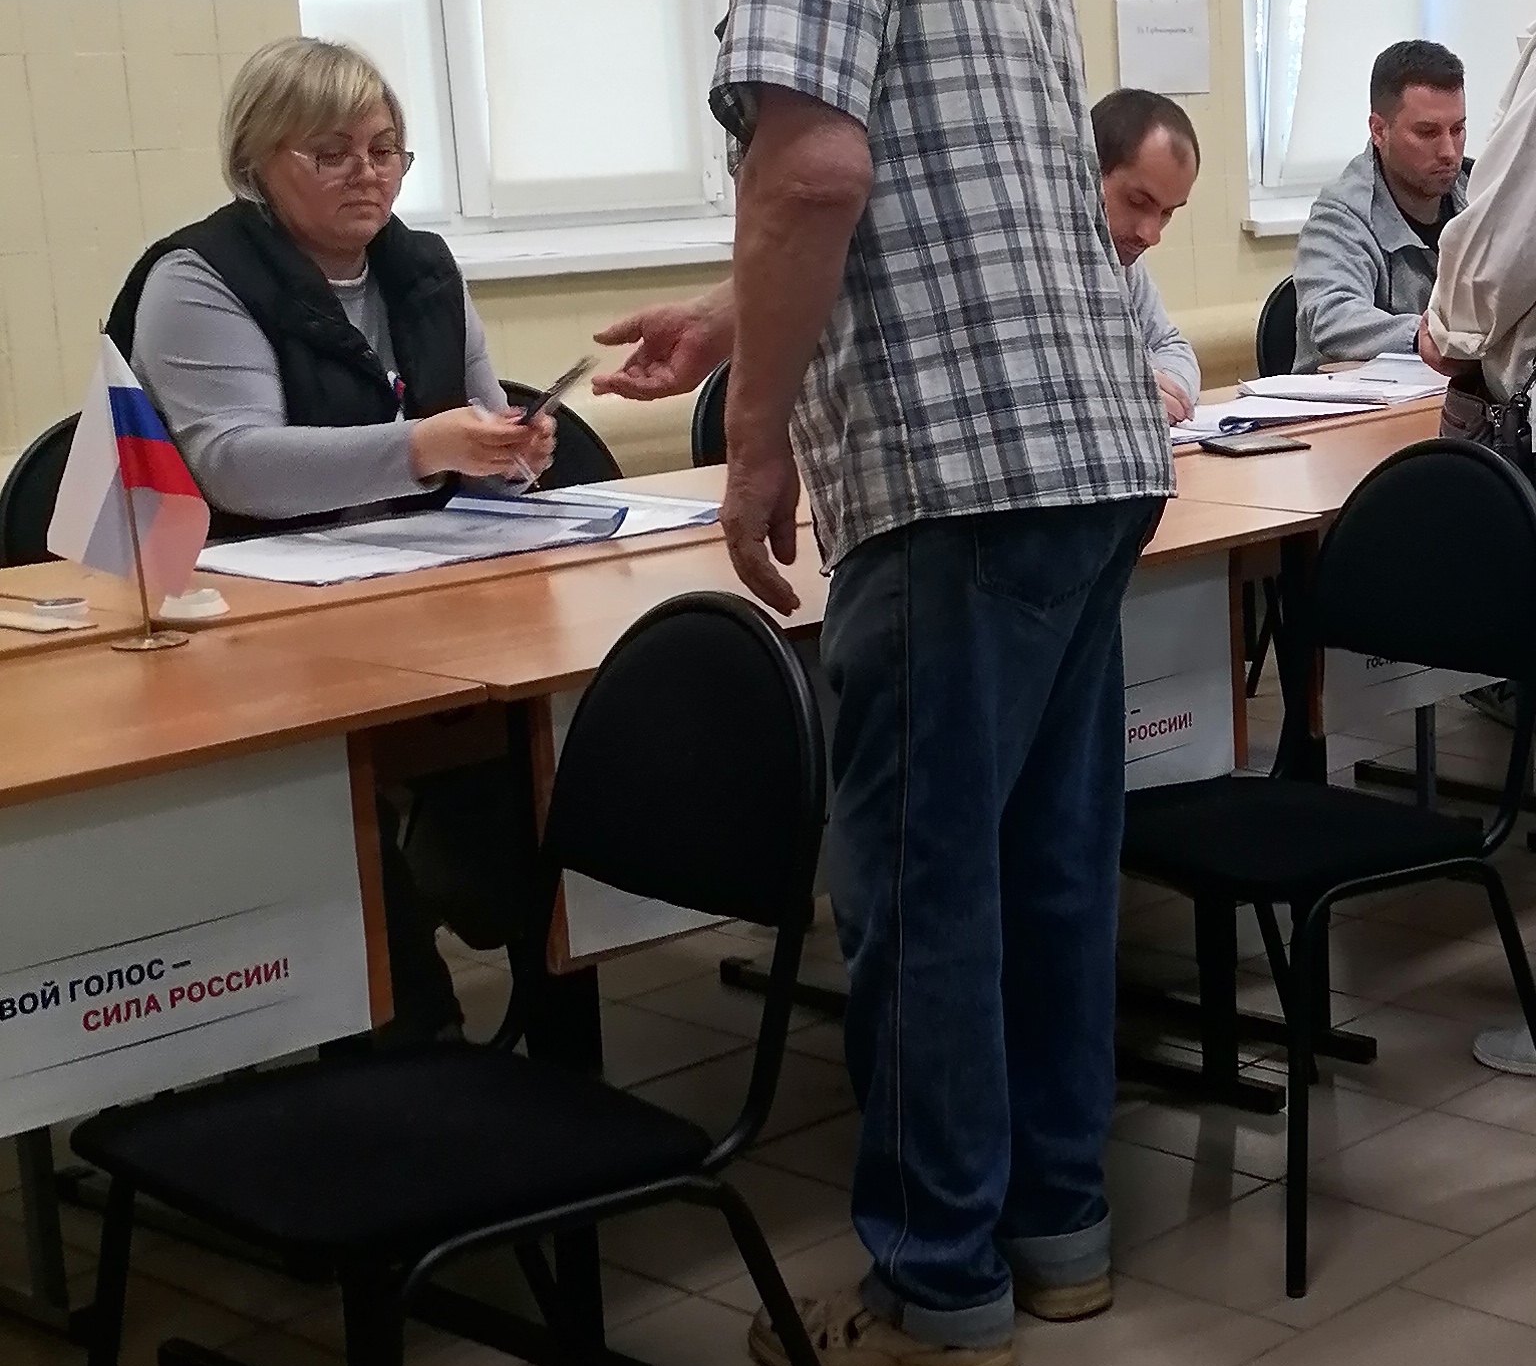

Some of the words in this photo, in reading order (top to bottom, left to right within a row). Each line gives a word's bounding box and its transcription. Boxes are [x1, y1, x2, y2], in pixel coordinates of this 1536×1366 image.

[1127, 711, 1193, 744] РОССИИ!
[68, 957, 165, 1003] ГОЛОС
[82, 993, 162, 1032] СИЛА
[169, 957, 290, 1009] РОССИИ!
